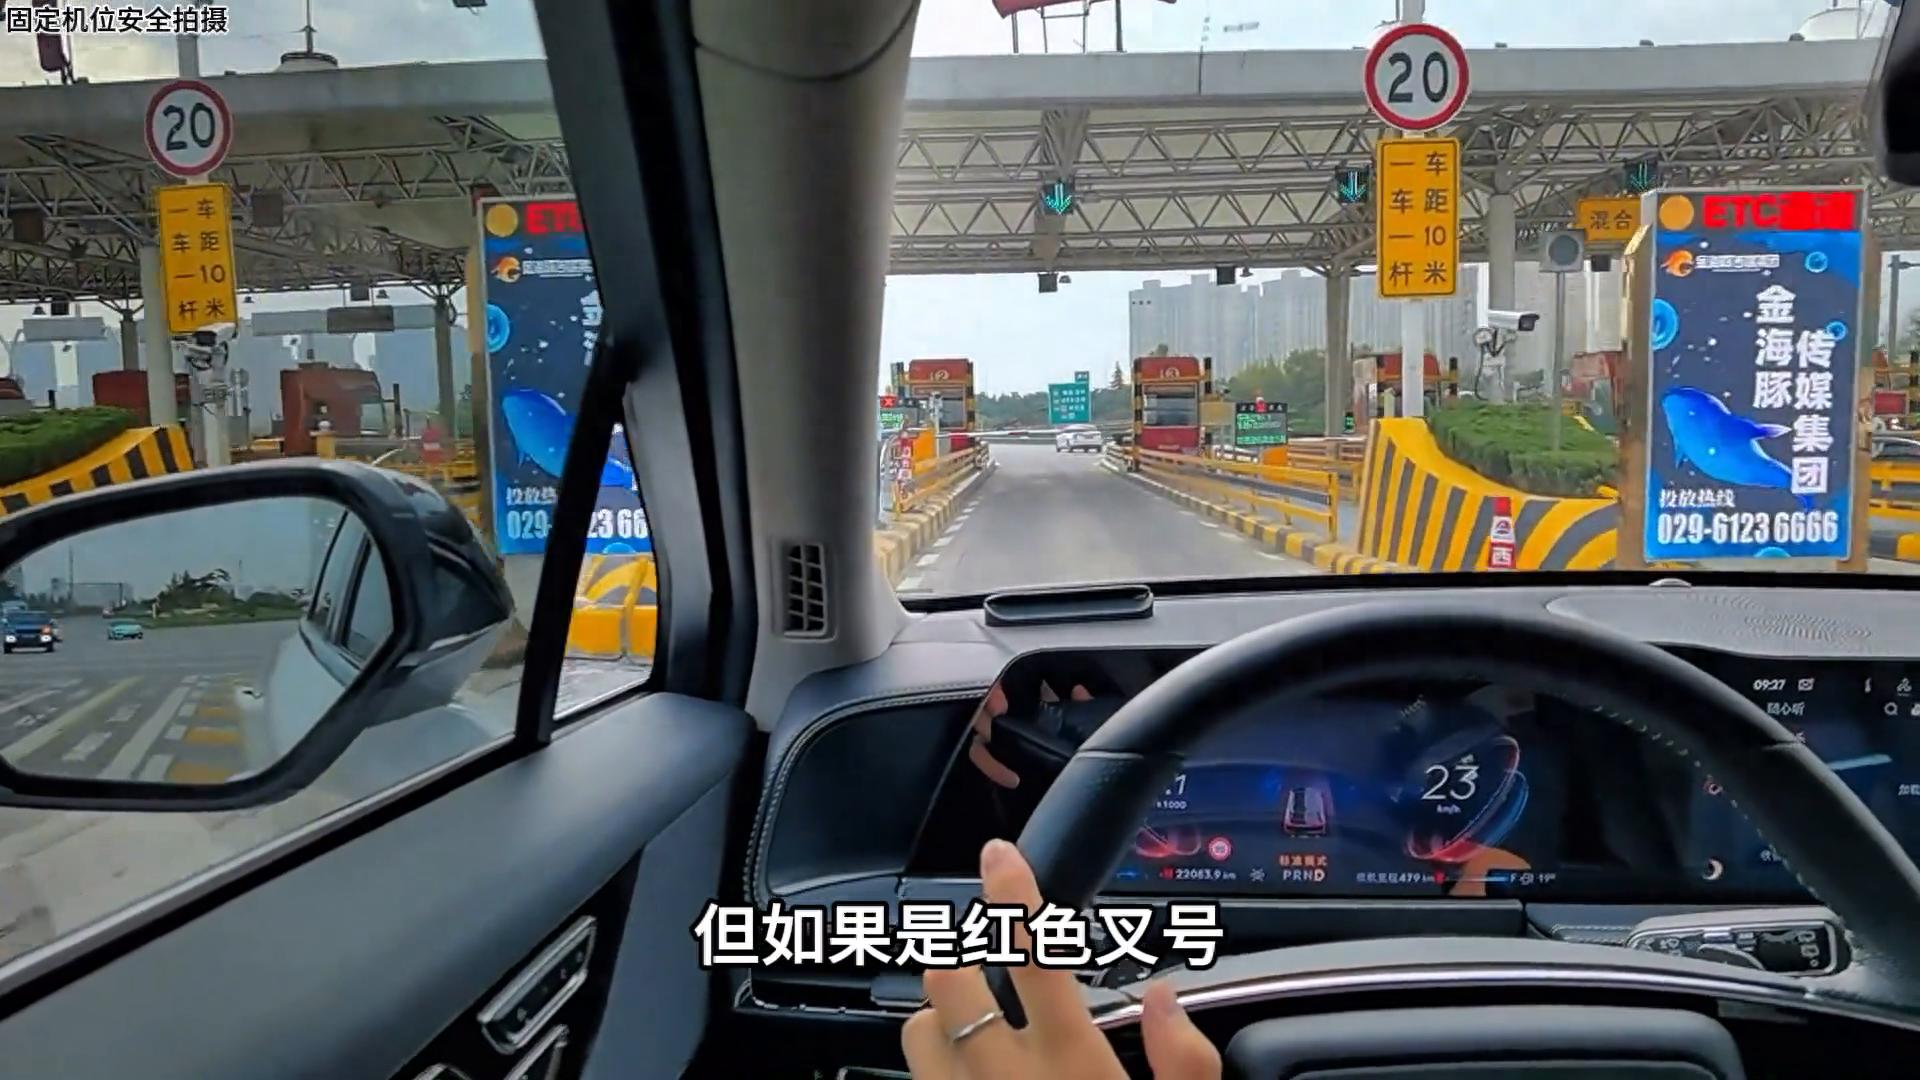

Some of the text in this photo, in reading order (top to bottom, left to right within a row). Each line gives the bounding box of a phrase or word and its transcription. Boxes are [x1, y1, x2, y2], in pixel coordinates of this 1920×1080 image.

[1387, 51, 1450, 104] 20
[161, 101, 216, 151] 20
[1588, 209, 1634, 232] 混合
[1753, 284, 1797, 410] 金海豚
[1790, 329, 1836, 495] 传媒集团
[1421, 764, 1479, 800] 23
